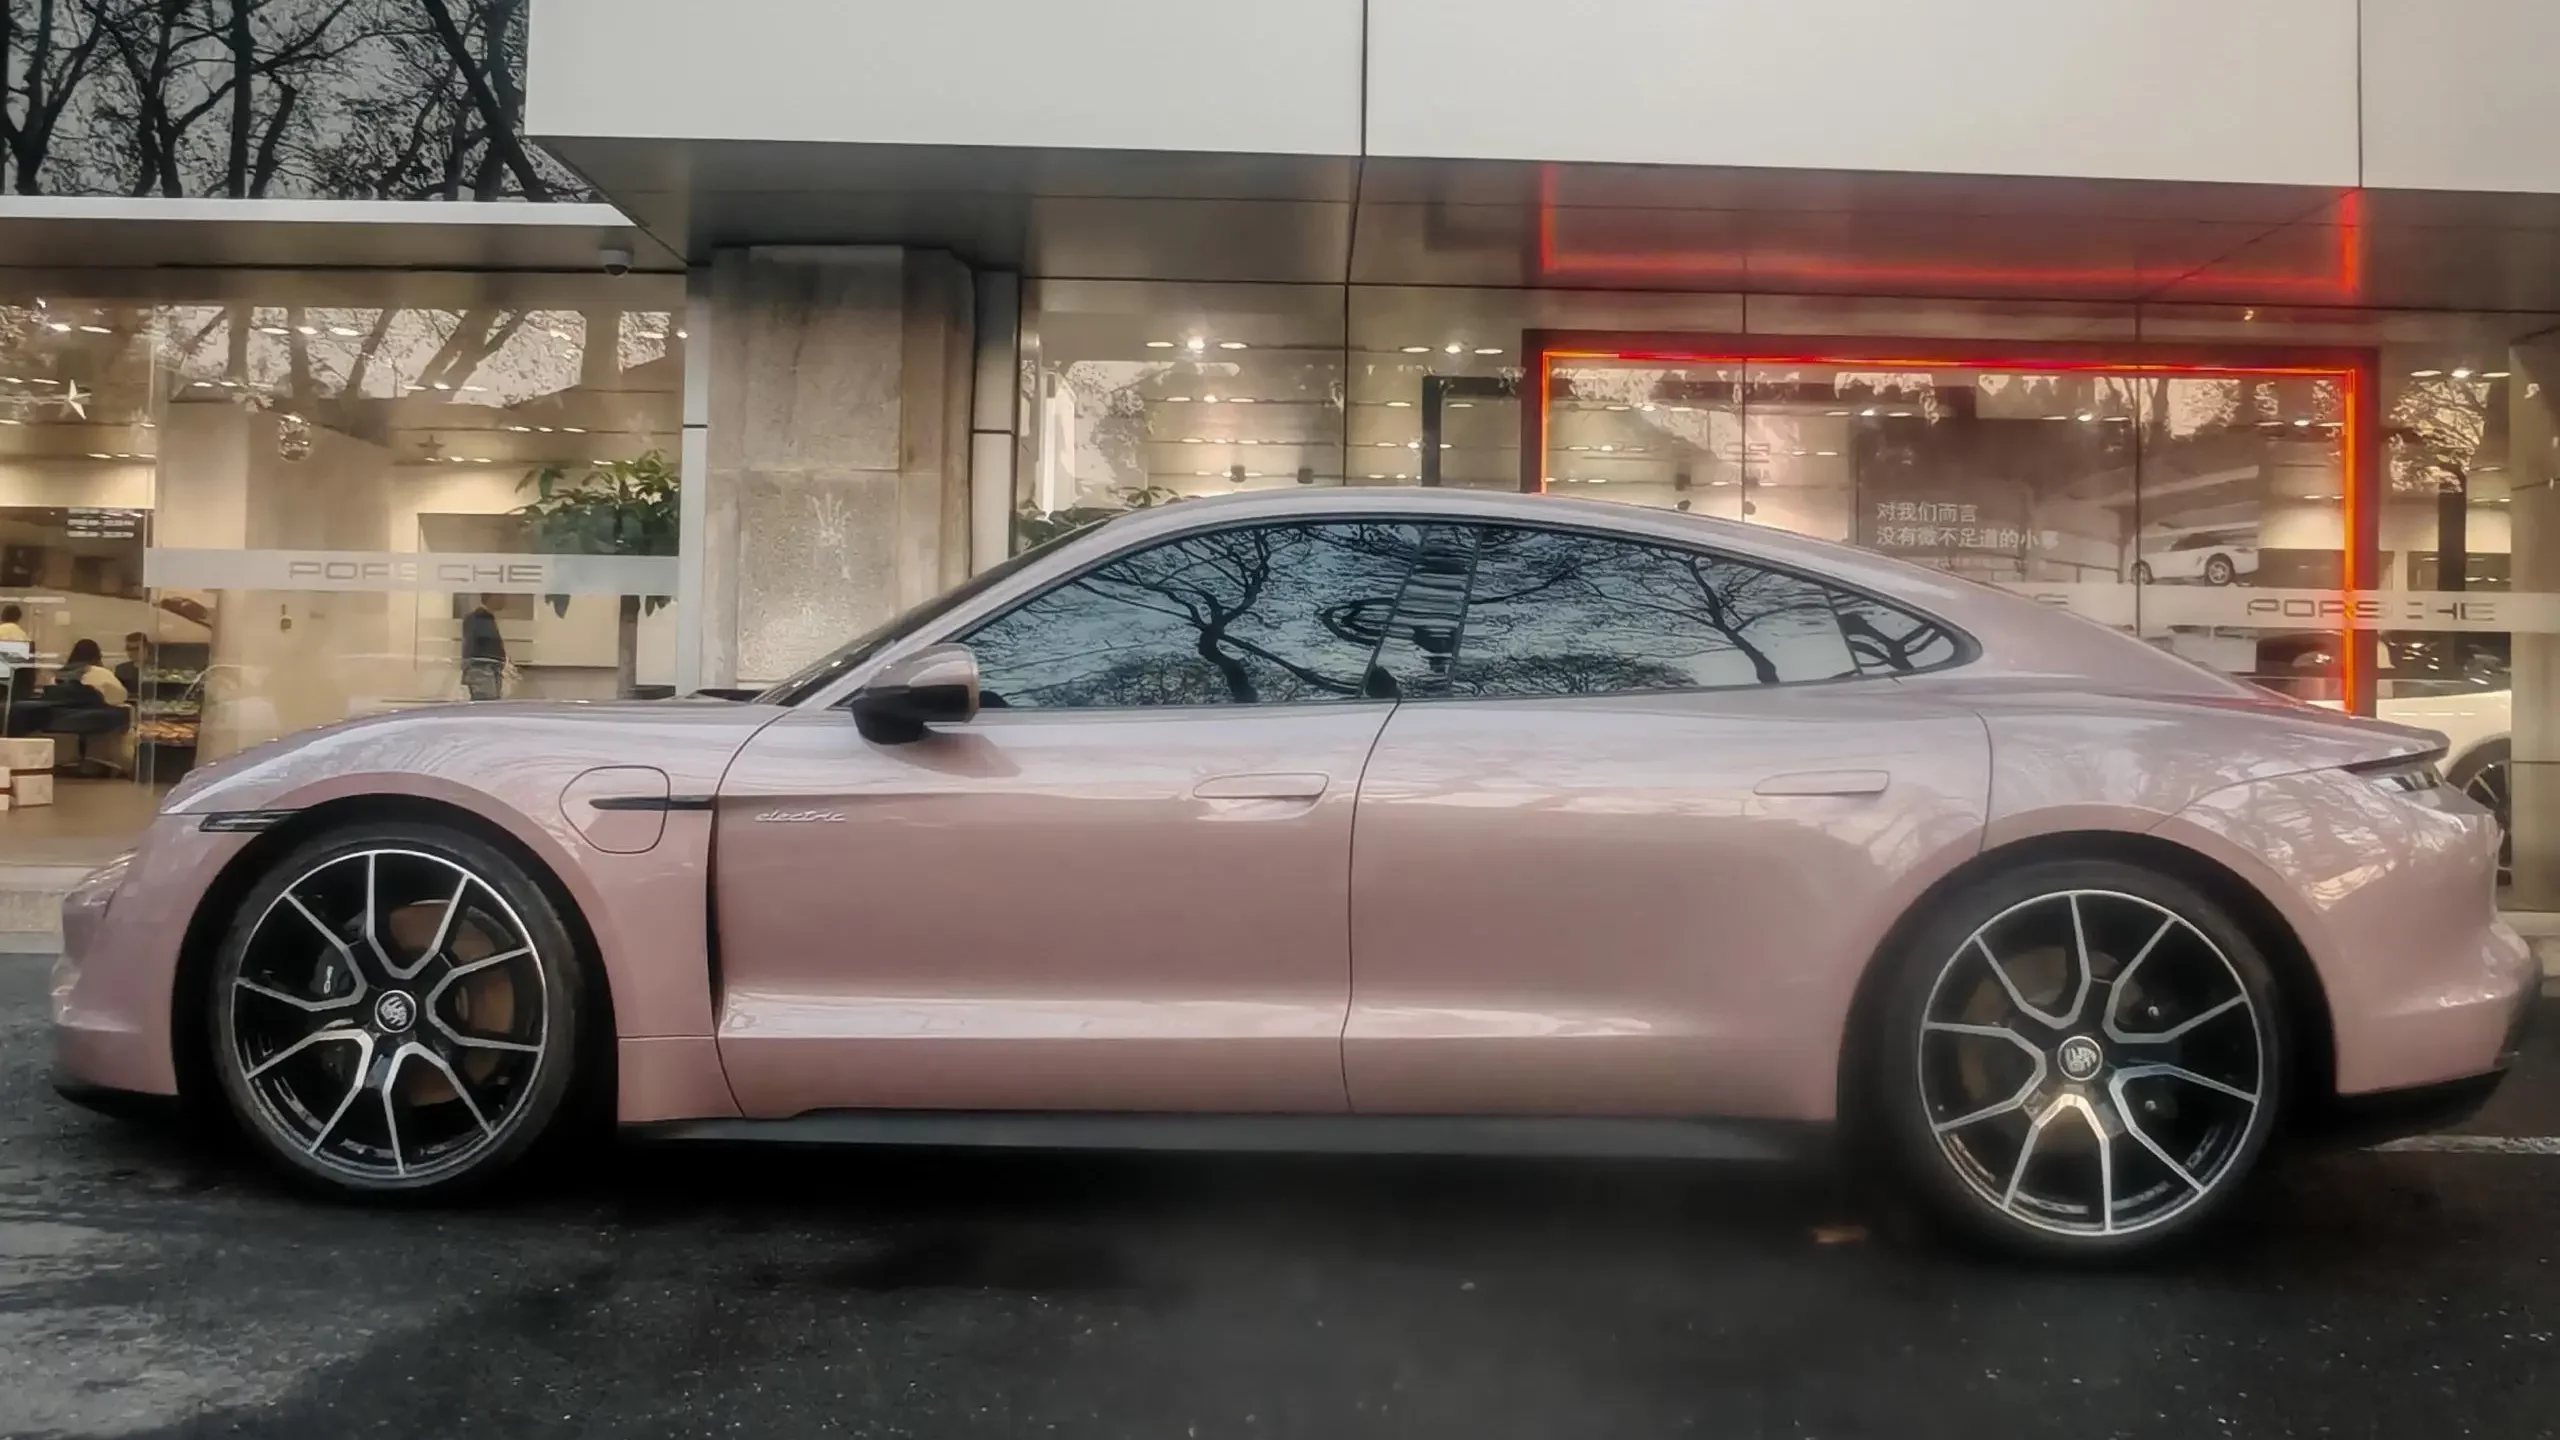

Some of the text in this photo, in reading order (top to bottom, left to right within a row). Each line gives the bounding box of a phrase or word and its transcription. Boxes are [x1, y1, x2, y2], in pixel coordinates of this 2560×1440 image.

[1876, 502, 1979, 523] 对我们而言
